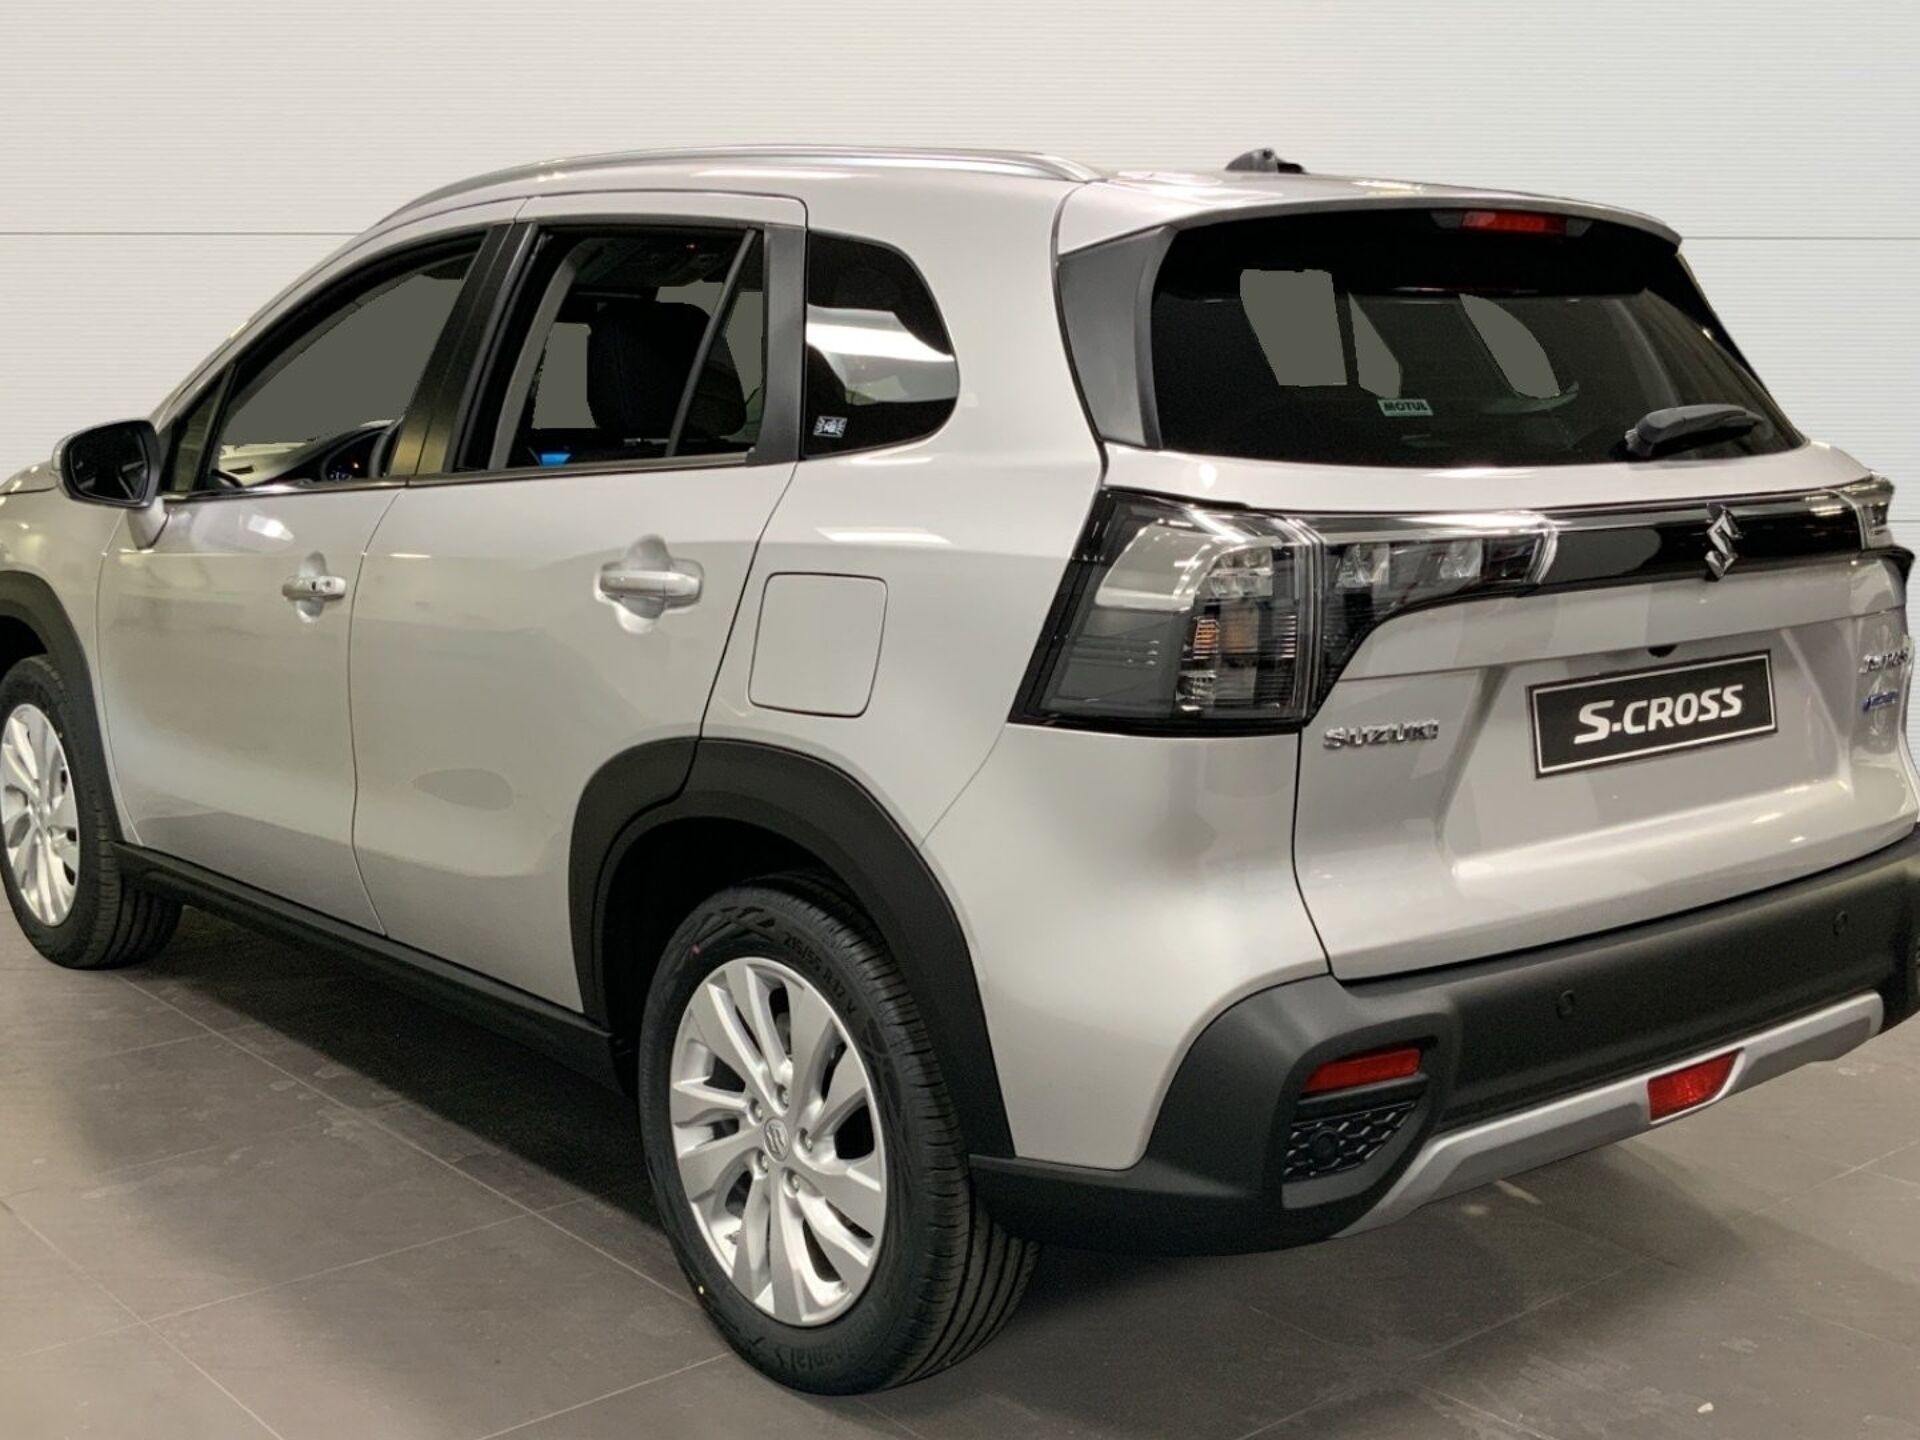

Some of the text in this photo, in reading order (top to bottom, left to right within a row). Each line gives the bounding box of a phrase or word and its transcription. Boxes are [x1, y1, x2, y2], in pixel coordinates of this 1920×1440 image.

[1383, 401, 1429, 412] MOTUL
[1574, 684, 1744, 744] S-CROSS
[1323, 720, 1439, 750] SUZUKI
